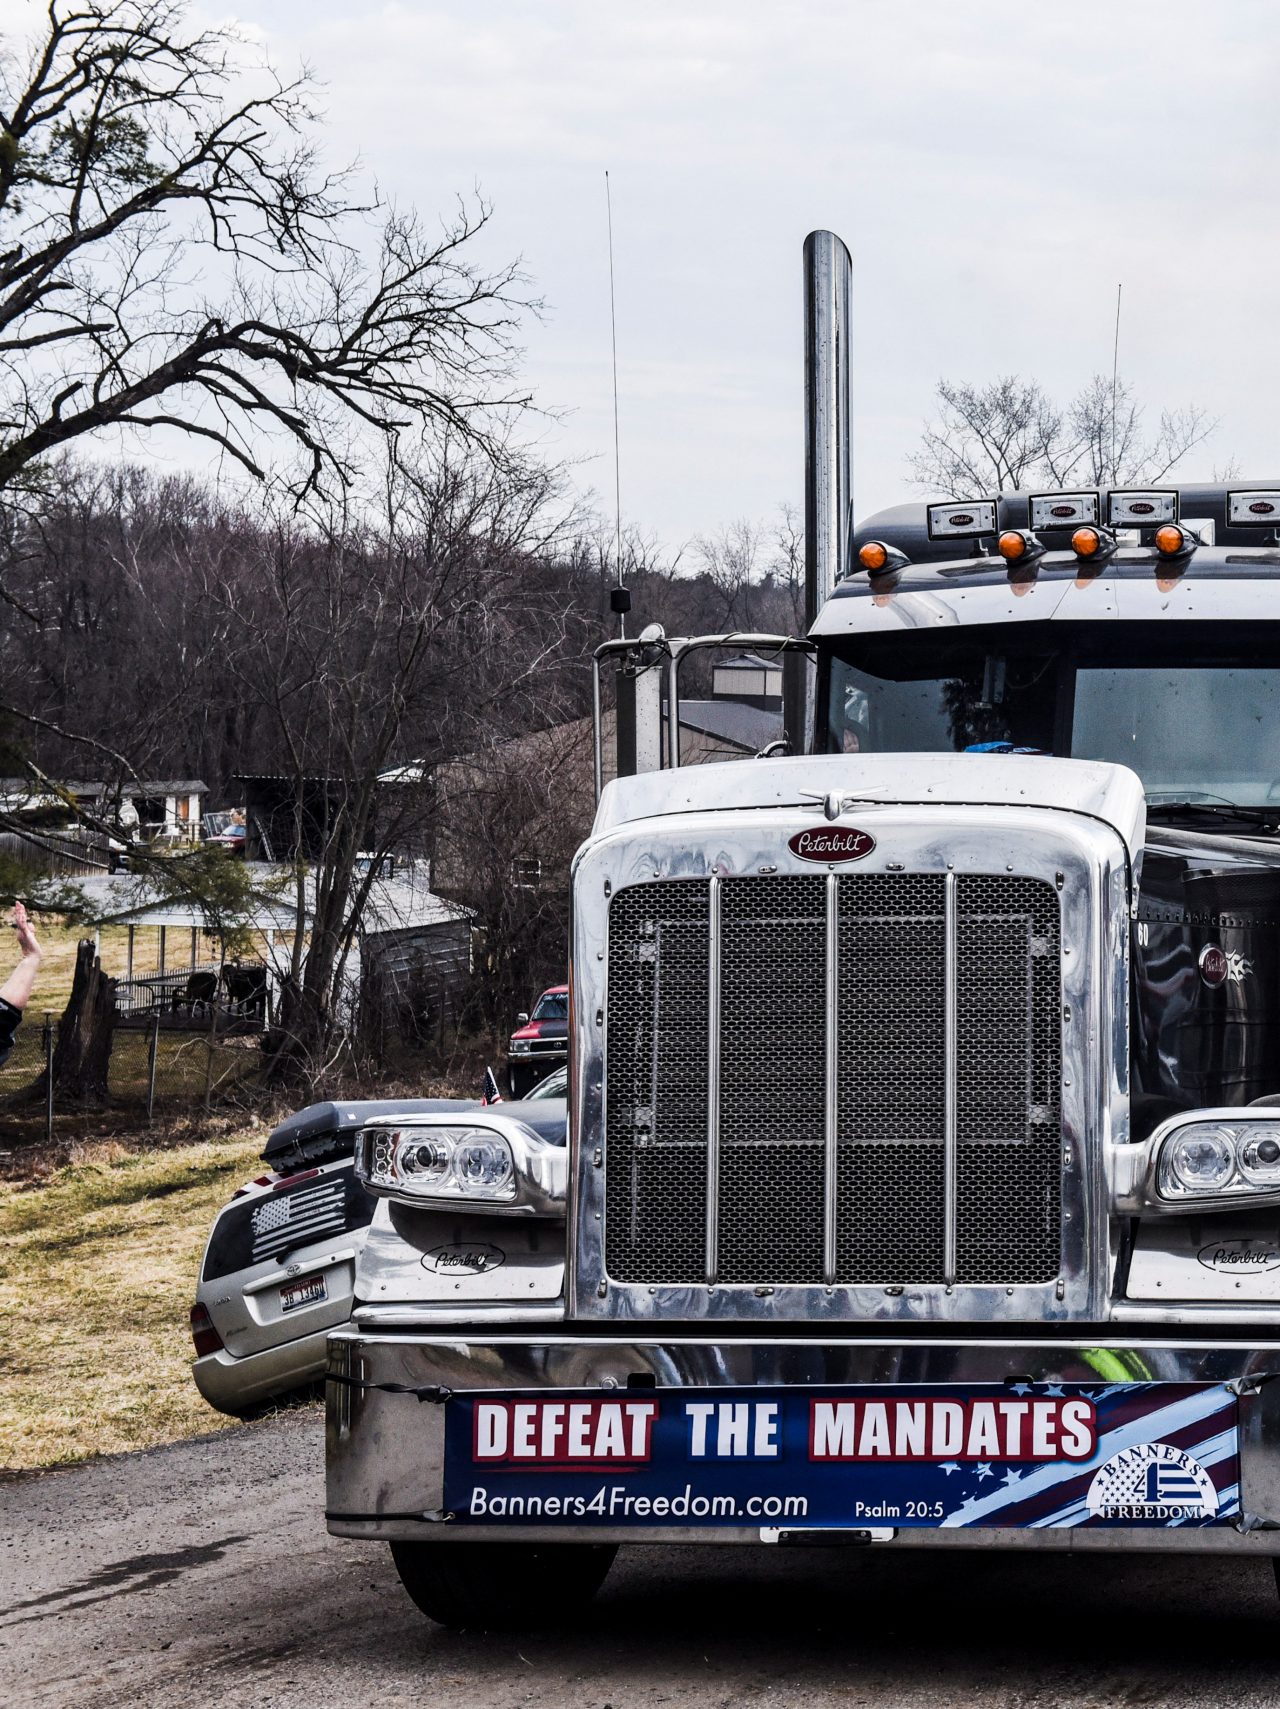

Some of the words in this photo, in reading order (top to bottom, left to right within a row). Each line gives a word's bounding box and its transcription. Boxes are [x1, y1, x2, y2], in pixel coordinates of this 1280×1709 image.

[798, 832, 867, 854] Peterbilt
[434, 1252, 495, 1268] Peterbilt
[1213, 1248, 1275, 1265] Peterbilt
[477, 1403, 654, 1457] DEFEAT
[685, 1403, 778, 1456] THE
[813, 1400, 1092, 1457] MANDATES
[1103, 1444, 1202, 1477] BANNERS
[1133, 1462, 1165, 1502] 4
[470, 1485, 808, 1517] Banners4Freedom.com
[855, 1501, 900, 1518] Psalm
[905, 1501, 944, 1518] 20:5
[1106, 1505, 1200, 1519] FREEDOM
